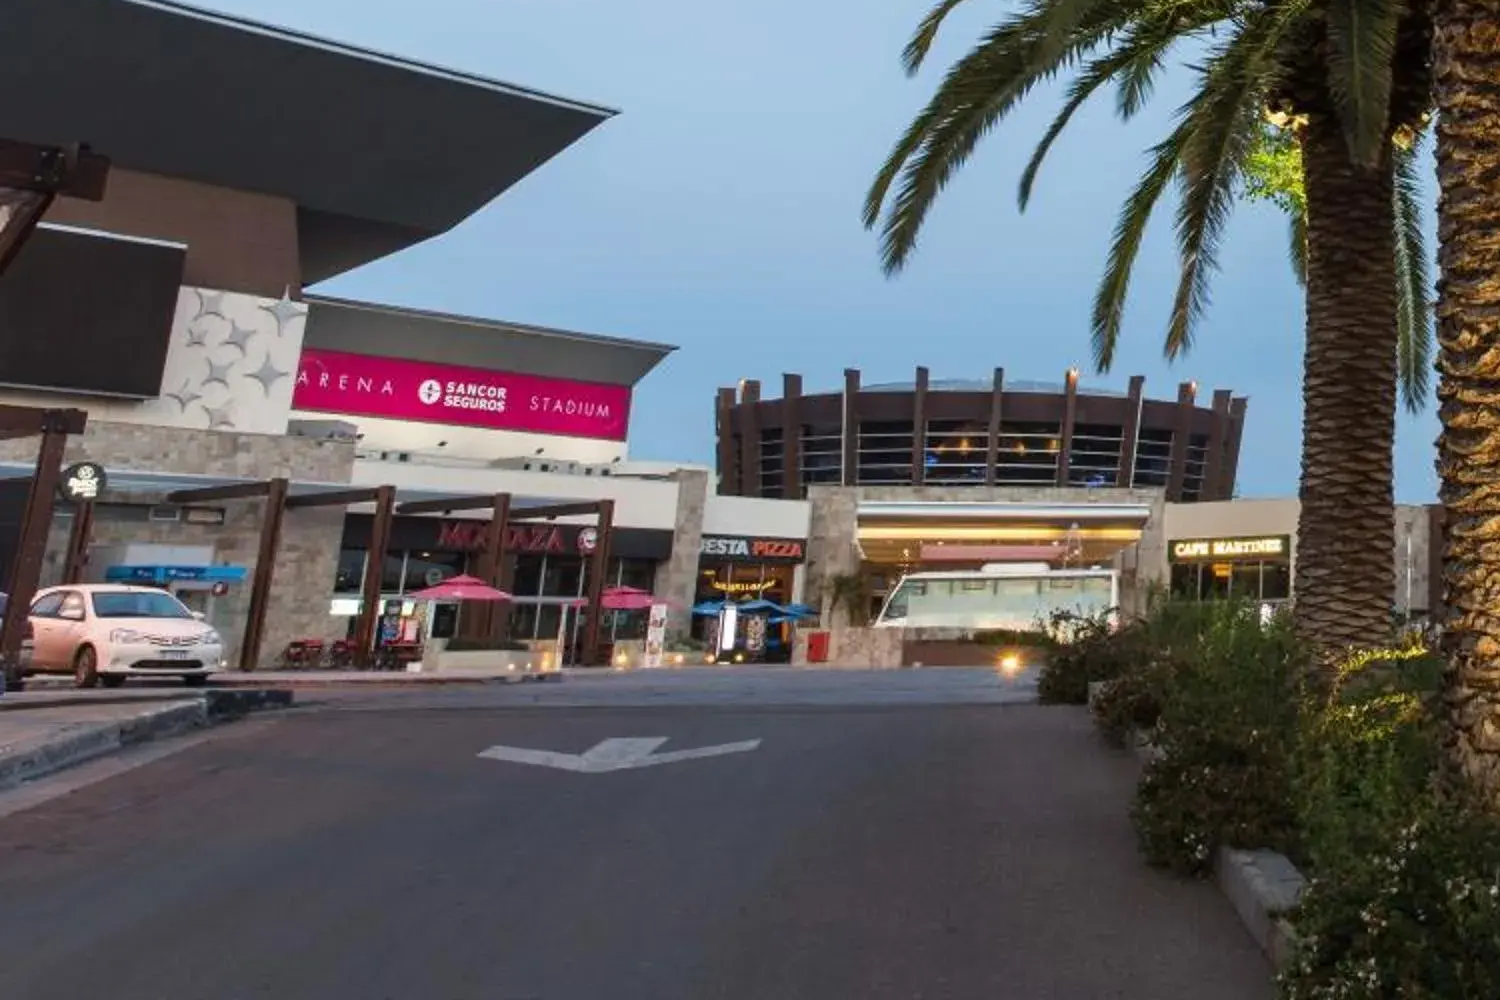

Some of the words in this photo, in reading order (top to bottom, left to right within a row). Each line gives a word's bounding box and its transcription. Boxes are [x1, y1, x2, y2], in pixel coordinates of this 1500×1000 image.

[297, 370, 394, 396] ARENA
[445, 381, 507, 398] SANCOR
[443, 396, 506, 413] SEGUROS
[529, 395, 610, 418] STADIUM
[751, 540, 802, 558] PIZZA
